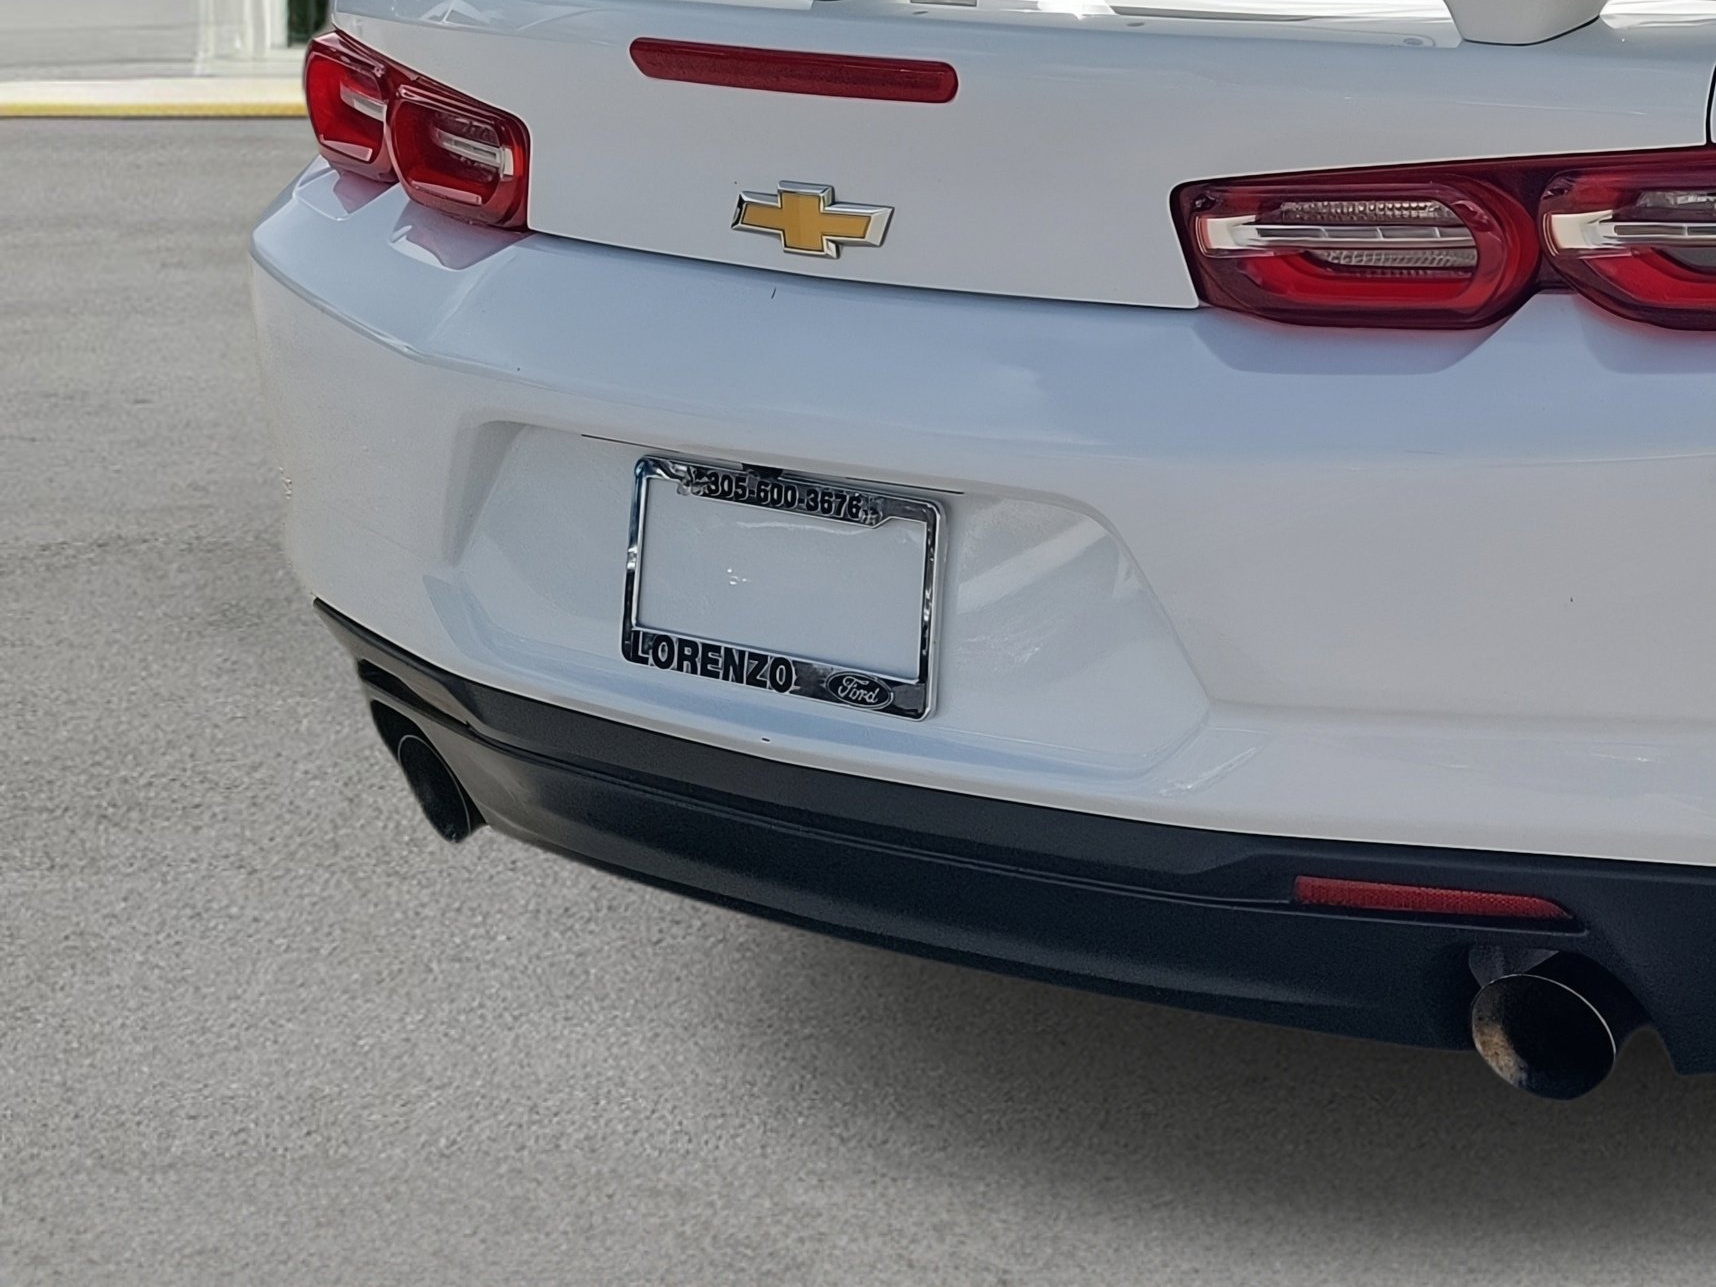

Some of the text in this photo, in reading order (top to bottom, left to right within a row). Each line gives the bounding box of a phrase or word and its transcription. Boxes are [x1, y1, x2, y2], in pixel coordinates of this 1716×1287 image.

[706, 470, 863, 521] 305-600-3676
[631, 630, 796, 694] LORENZO
[837, 675, 881, 704] Ford
